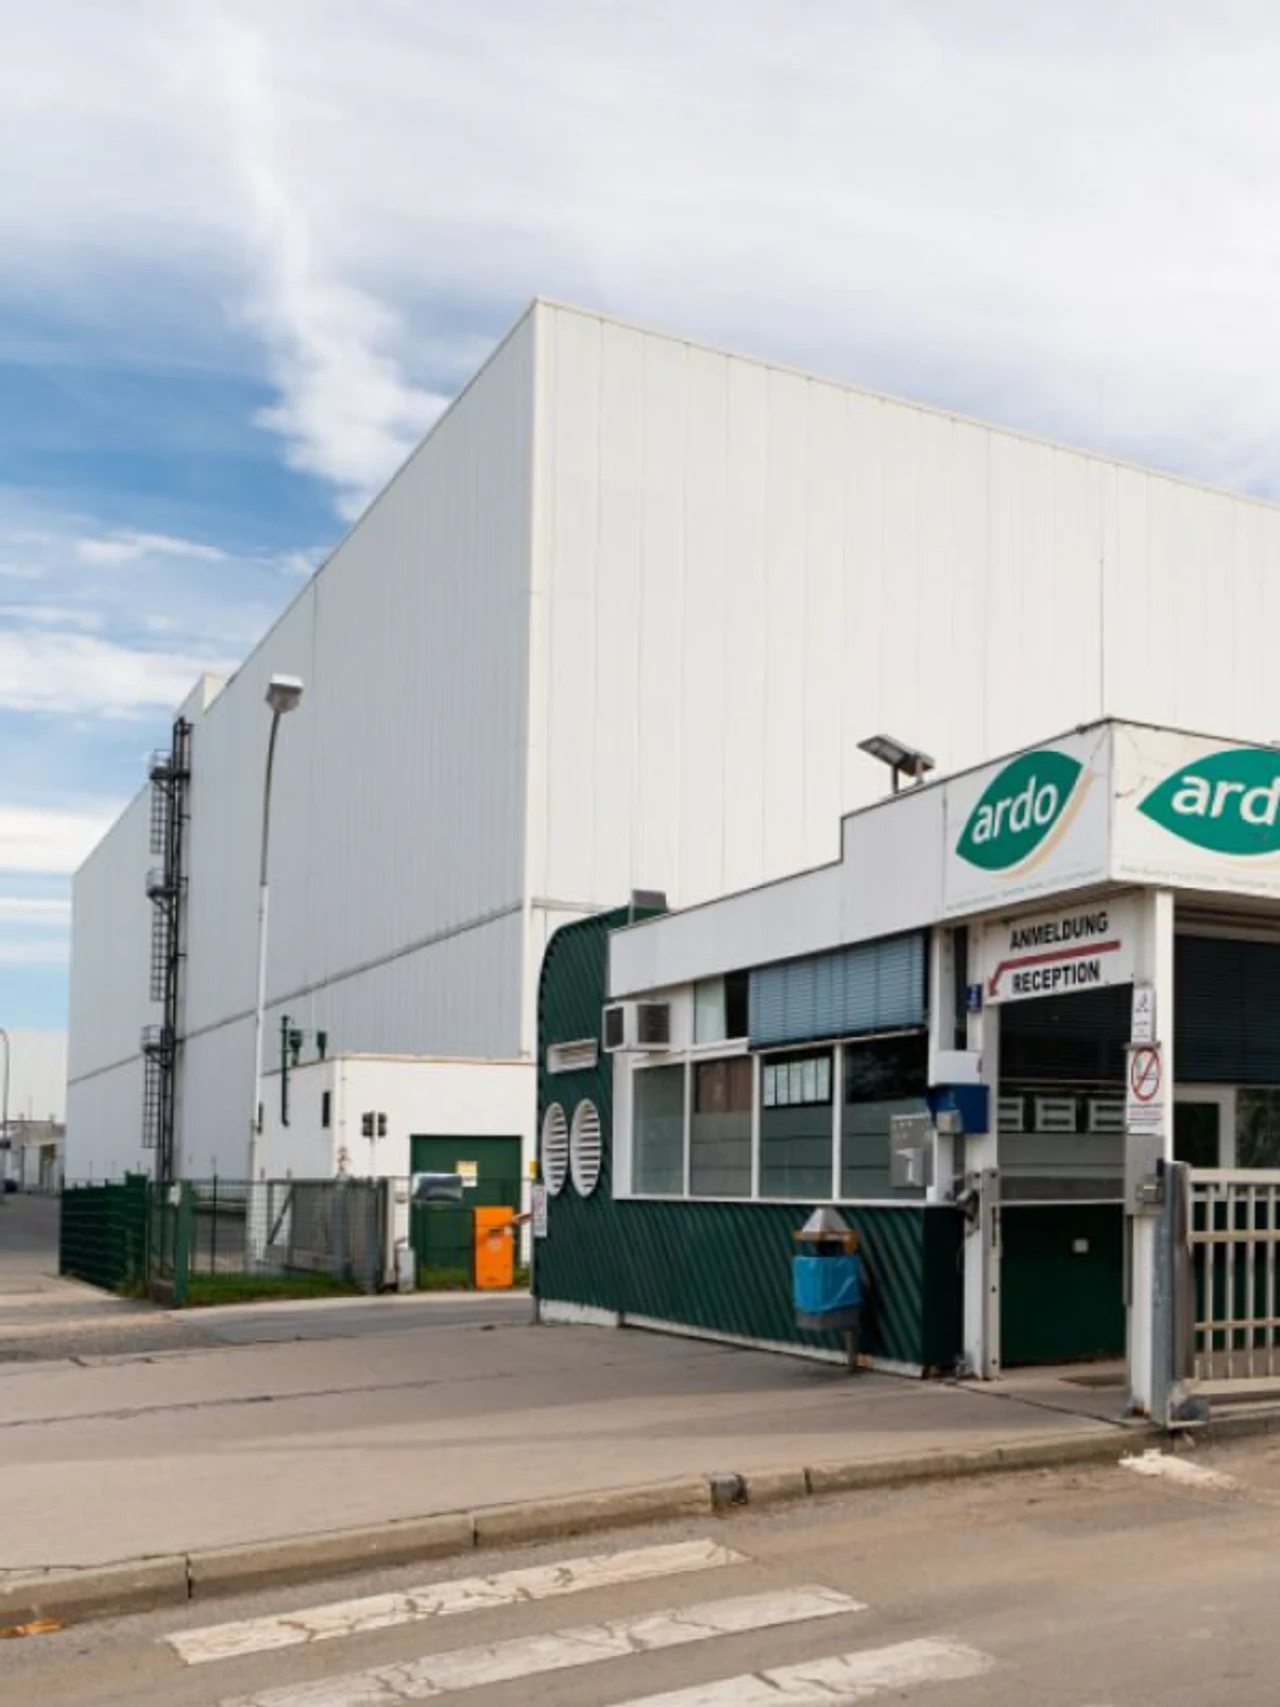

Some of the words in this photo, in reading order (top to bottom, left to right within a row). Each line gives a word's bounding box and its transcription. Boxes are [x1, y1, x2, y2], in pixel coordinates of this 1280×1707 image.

[971, 775, 1058, 844] ardo
[1010, 912, 1108, 950] ANMELDUNG
[1013, 961, 1100, 993] RECEPTION
